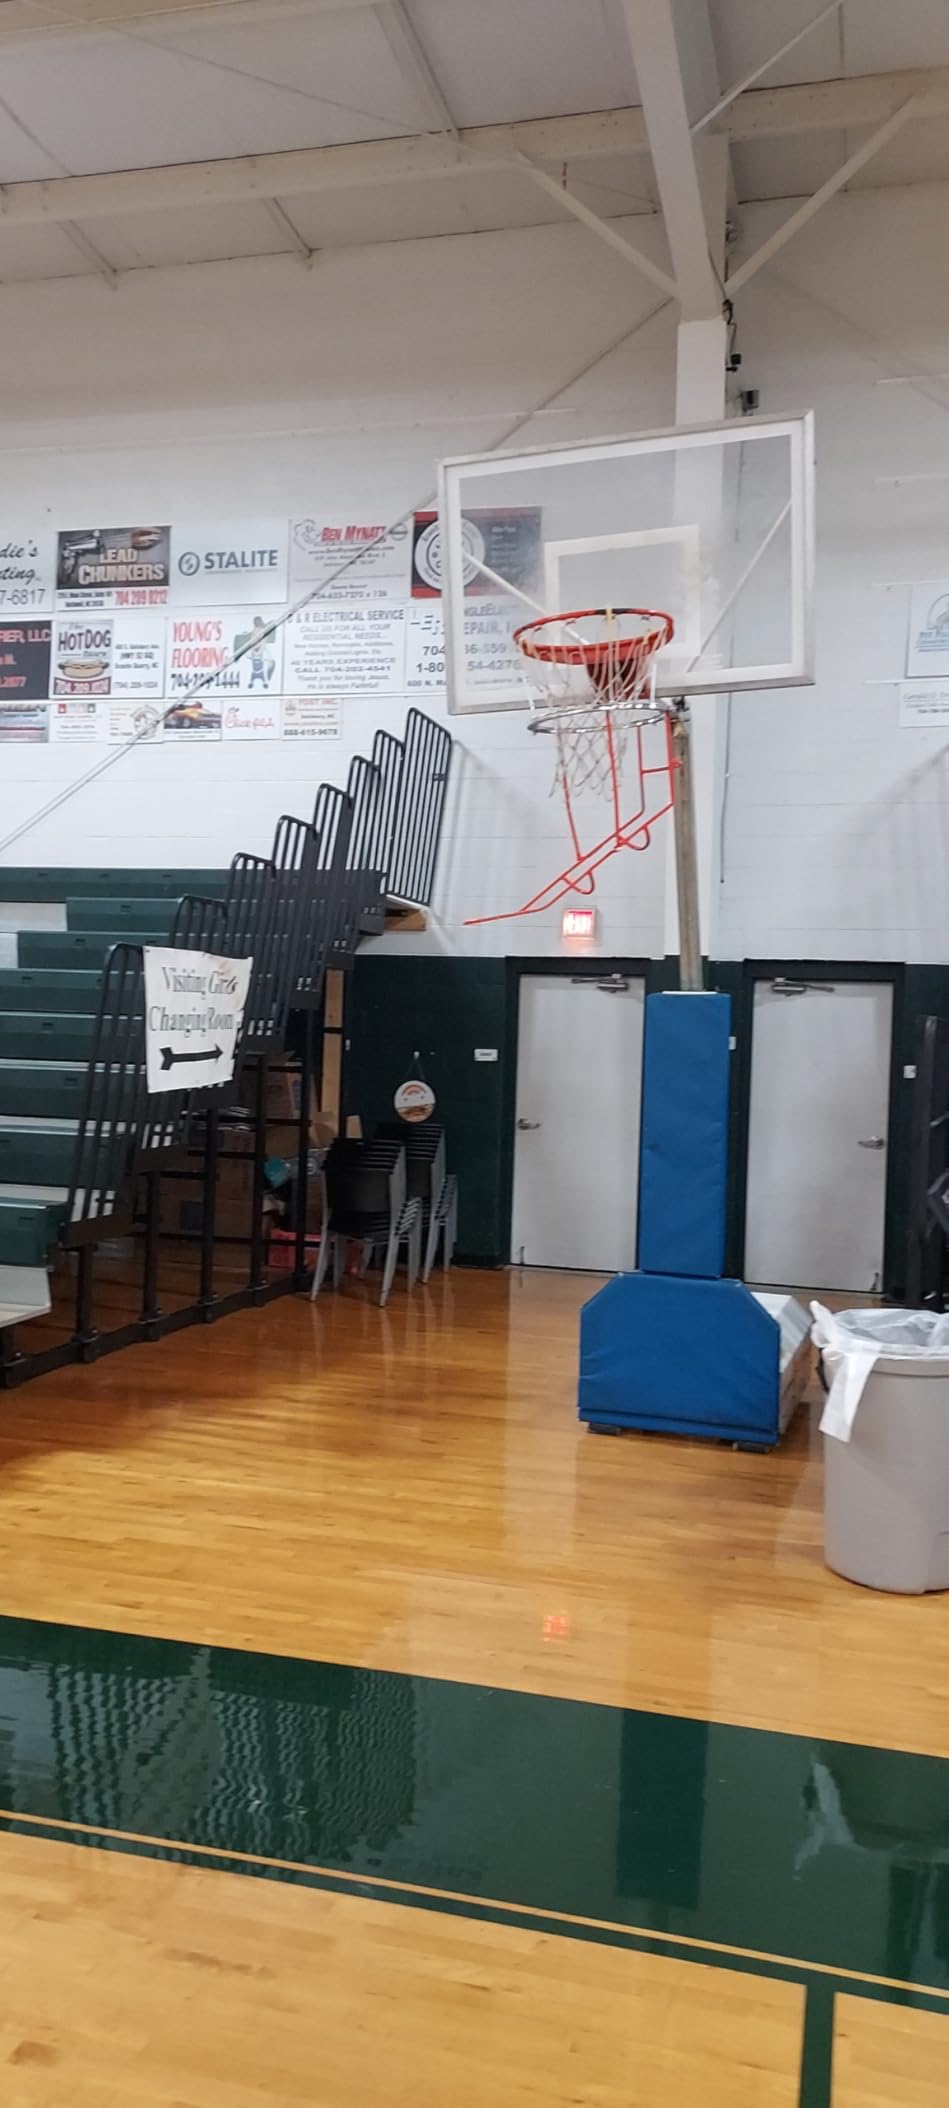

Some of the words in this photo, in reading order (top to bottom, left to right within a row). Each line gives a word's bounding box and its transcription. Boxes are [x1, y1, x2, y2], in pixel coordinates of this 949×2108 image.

[321, 526, 342, 542] BEN
[100, 547, 138, 564] LEAD
[204, 549, 279, 569] STALITE
[78, 563, 165, 585] CHUNKERS
[313, 610, 364, 622] ELECTRICAL
[367, 608, 405, 621] SERVICE
[173, 620, 223, 642] YOUNG'S
[161, 966, 207, 1000] Visiting
[149, 1005, 207, 1038] Changing
[207, 1006, 234, 1030] Room
